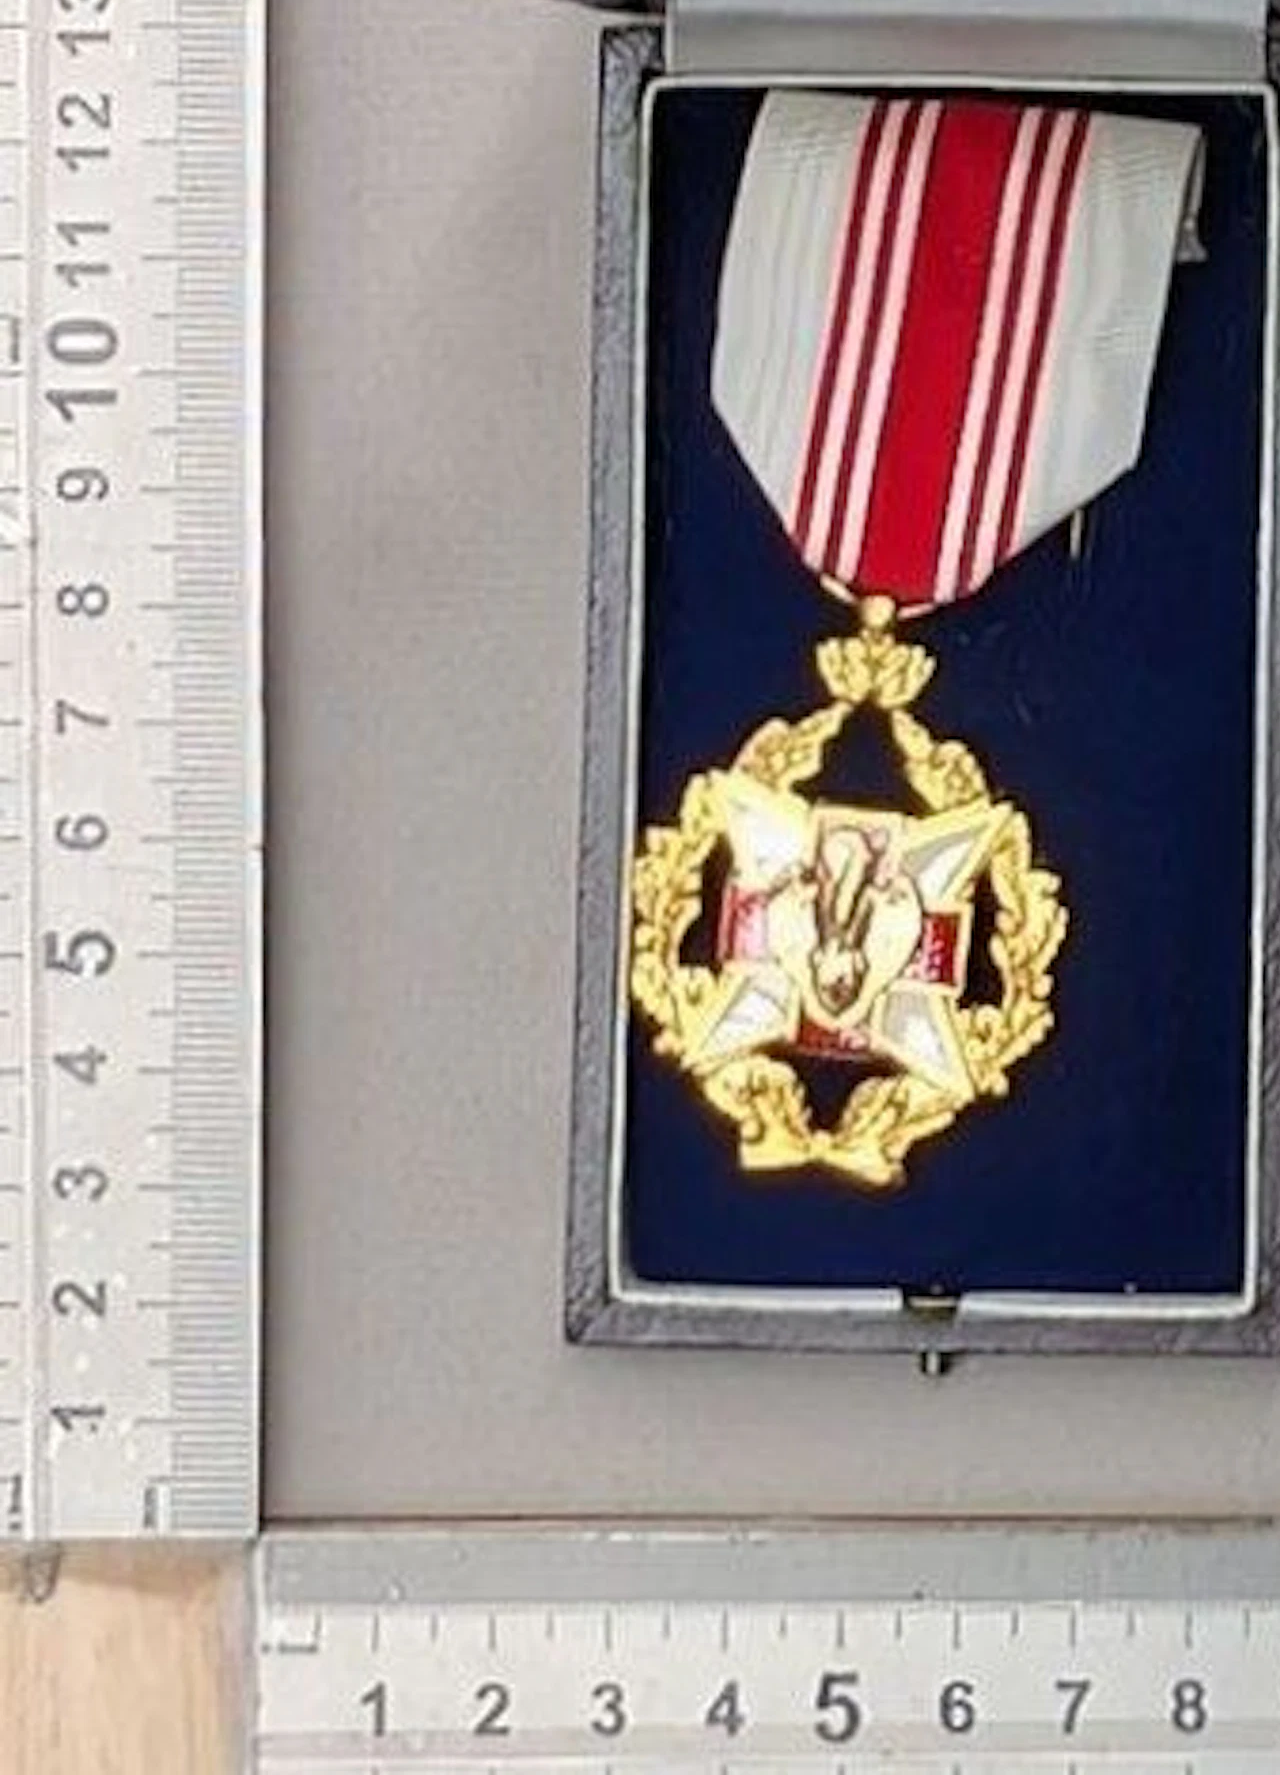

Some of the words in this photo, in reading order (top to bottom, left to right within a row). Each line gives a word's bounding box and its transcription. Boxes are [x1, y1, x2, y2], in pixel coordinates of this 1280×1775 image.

[56, 95, 110, 171] 12
[56, 223, 109, 287] 11
[45, 320, 118, 422] 10
[56, 469, 109, 502] 9
[56, 584, 109, 618] 8
[56, 700, 108, 734] 7
[55, 815, 108, 850] 6
[44, 931, 116, 976] 5
[54, 1047, 106, 1084] 4
[53, 1166, 108, 1201] 3
[51, 1281, 106, 1317] 2
[50, 1406, 105, 1432] 1
[361, 1683, 385, 1737] 1
[473, 1683, 510, 1738] 2
[592, 1683, 626, 1738] 3
[705, 1681, 744, 1737] 4
[815, 1672, 861, 1744] 5
[939, 1681, 975, 1735] 6
[1056, 1680, 1091, 1735] 7
[1171, 1679, 1207, 1735] 8
